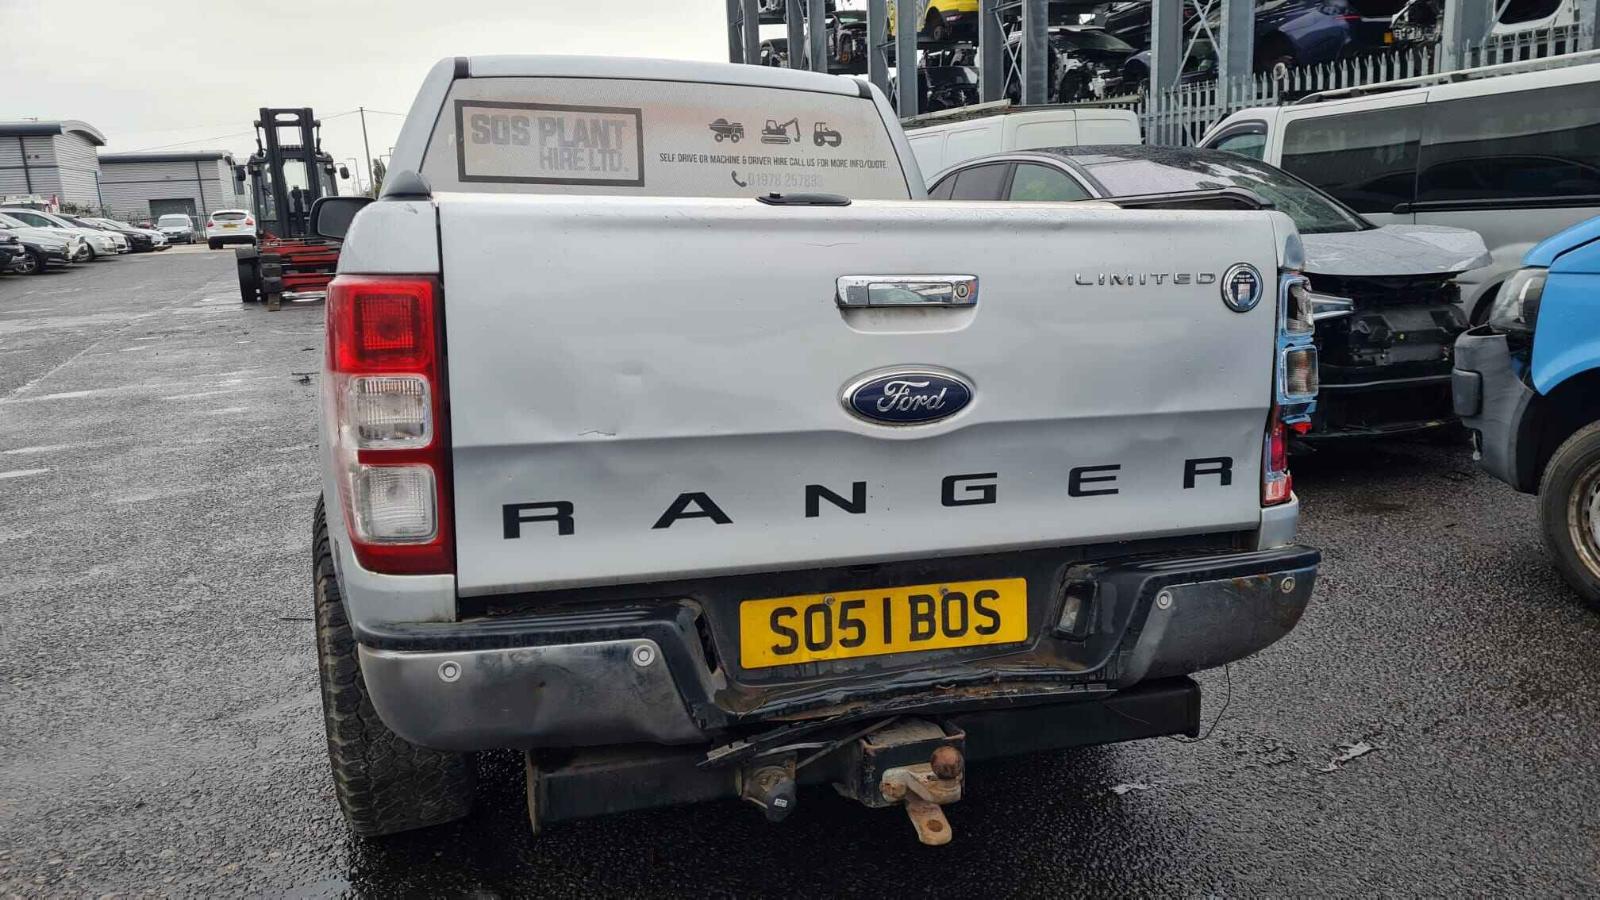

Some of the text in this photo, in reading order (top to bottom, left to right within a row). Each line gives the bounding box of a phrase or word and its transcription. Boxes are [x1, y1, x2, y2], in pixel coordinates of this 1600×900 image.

[471, 113, 627, 148] SOS PLANT
[539, 148, 584, 171] HIRE
[659, 152, 676, 163] SELF
[677, 153, 698, 163] DRIVE
[699, 154, 709, 164] OR
[710, 154, 741, 165] MACHINE
[747, 156, 772, 166] DRIVER
[773, 157, 788, 166] HIRE
[789, 157, 806, 167] CALL
[806, 158, 815, 167] US
[817, 158, 829, 168] FOR
[830, 159, 848, 168] MORE
[1074, 271, 1217, 287] LIMITED
[876, 380, 948, 412] Ford
[502, 456, 1233, 539] RANGER
